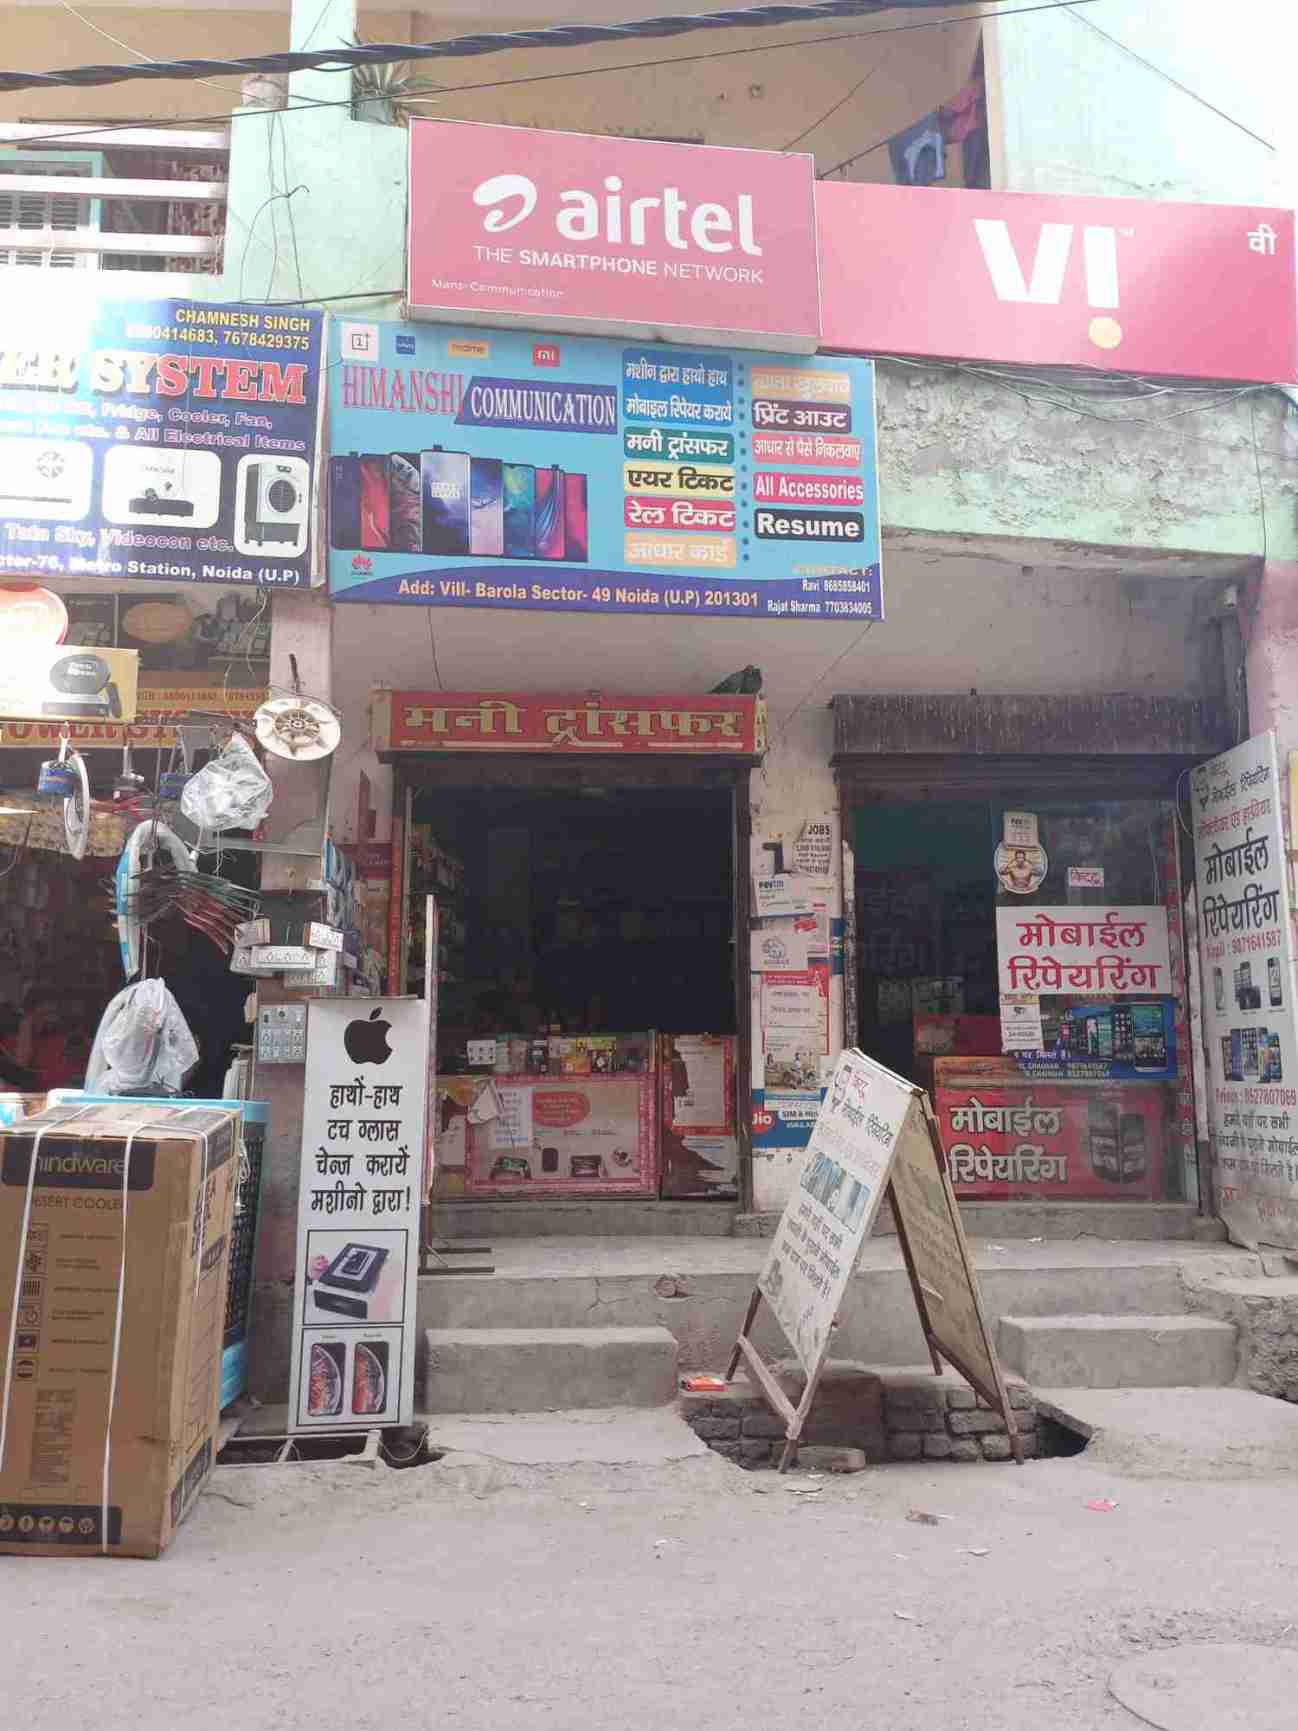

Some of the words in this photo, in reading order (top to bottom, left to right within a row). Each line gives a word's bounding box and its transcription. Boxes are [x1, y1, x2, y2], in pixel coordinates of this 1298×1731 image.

[555, 176, 763, 256] airtel
[1247, 223, 1279, 255] वी
[473, 245, 512, 264] THE
[518, 249, 657, 276] SMARTPHONE
[663, 261, 763, 285] NETWORK
[175, 308, 259, 329] CHAMNESH
[263, 314, 311, 332] SINGH
[91, 350, 309, 405] SYSTEM
[471, 386, 616, 428] COMMUNICATION
[753, 401, 790, 425] प्रिंट
[793, 410, 848, 428] आउट
[130, 427, 160, 442] All
[163, 428, 250, 449] Electrical
[254, 434, 306, 451] Items
[626, 428, 662, 453] मनी
[667, 432, 729, 460] ट्रांसफर
[627, 468, 673, 489] एयर
[678, 466, 735, 491] टिकट
[755, 475, 774, 497] All
[779, 477, 864, 499] Accessories
[627, 499, 666, 524] रेल
[671, 501, 736, 528] टिकट
[757, 512, 860, 537] Resume
[196, 535, 235, 552] etc.
[127, 560, 197, 581] Station,
[202, 564, 253, 581] Noida
[258, 568, 301, 585] (U.P)
[398, 579, 436, 596] Add:
[440, 580, 471, 597] Vill-
[475, 581, 528, 599] Barola
[531, 582, 588, 601] Sector-
[592, 588, 611, 603] 49
[615, 587, 659, 604] Noida
[664, 589, 700, 608] (U.P)
[705, 592, 759, 608] 201301
[403, 700, 528, 735] मनी
[1016, 911, 1147, 948] मोबाईल
[1008, 954, 1163, 991] रिपेयरिंग
[327, 1119, 353, 1142] टच
[358, 1119, 402, 1142] ग्लास
[949, 1096, 1064, 1137] मोबाईल
[948, 1143, 1068, 1184] रिपेयरिंग
